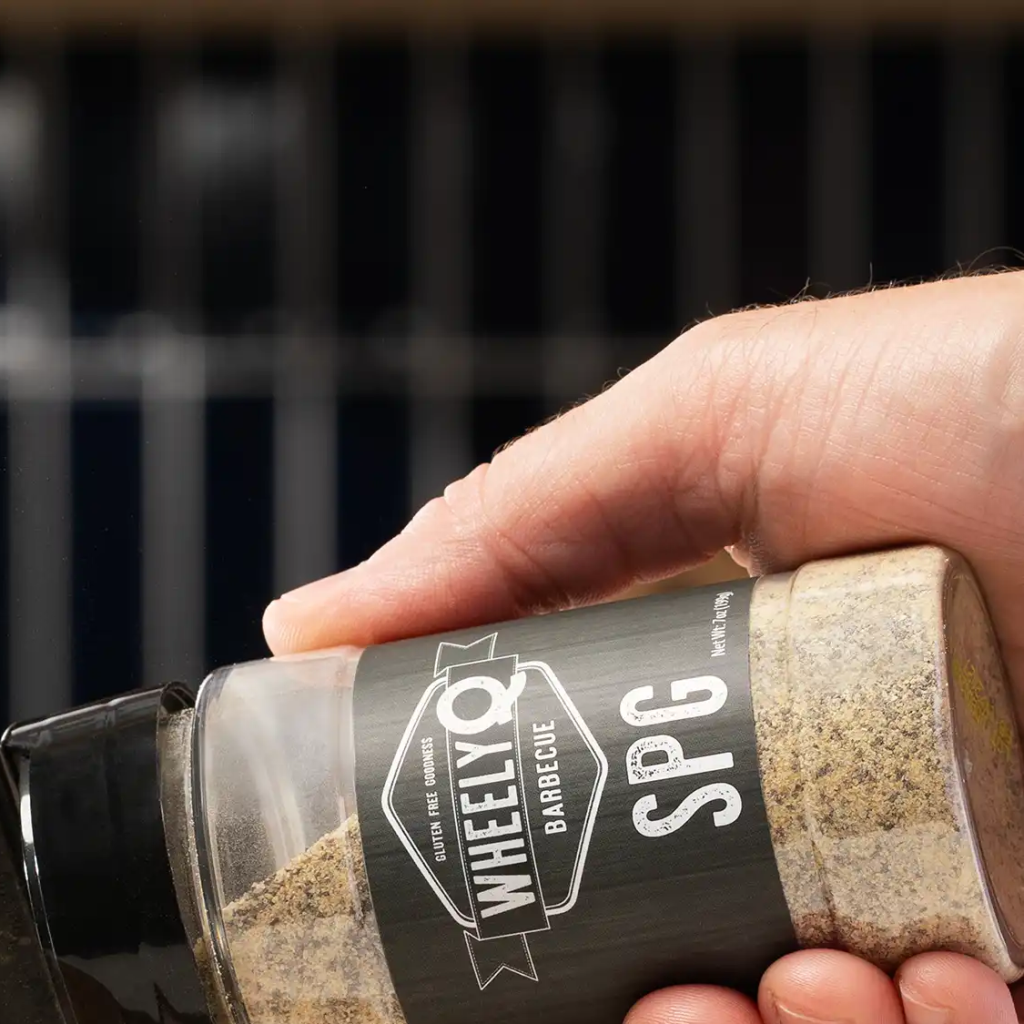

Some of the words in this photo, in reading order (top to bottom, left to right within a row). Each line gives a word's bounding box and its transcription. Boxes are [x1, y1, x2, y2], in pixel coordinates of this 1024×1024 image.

[710, 639, 726, 657] Net
[421, 736, 436, 787] GOODNESS
[533, 719, 568, 835] BARBECUE
[619, 675, 743, 838] SPG
[425, 791, 440, 817] FREE
[430, 821, 447, 862] GLUTEN
